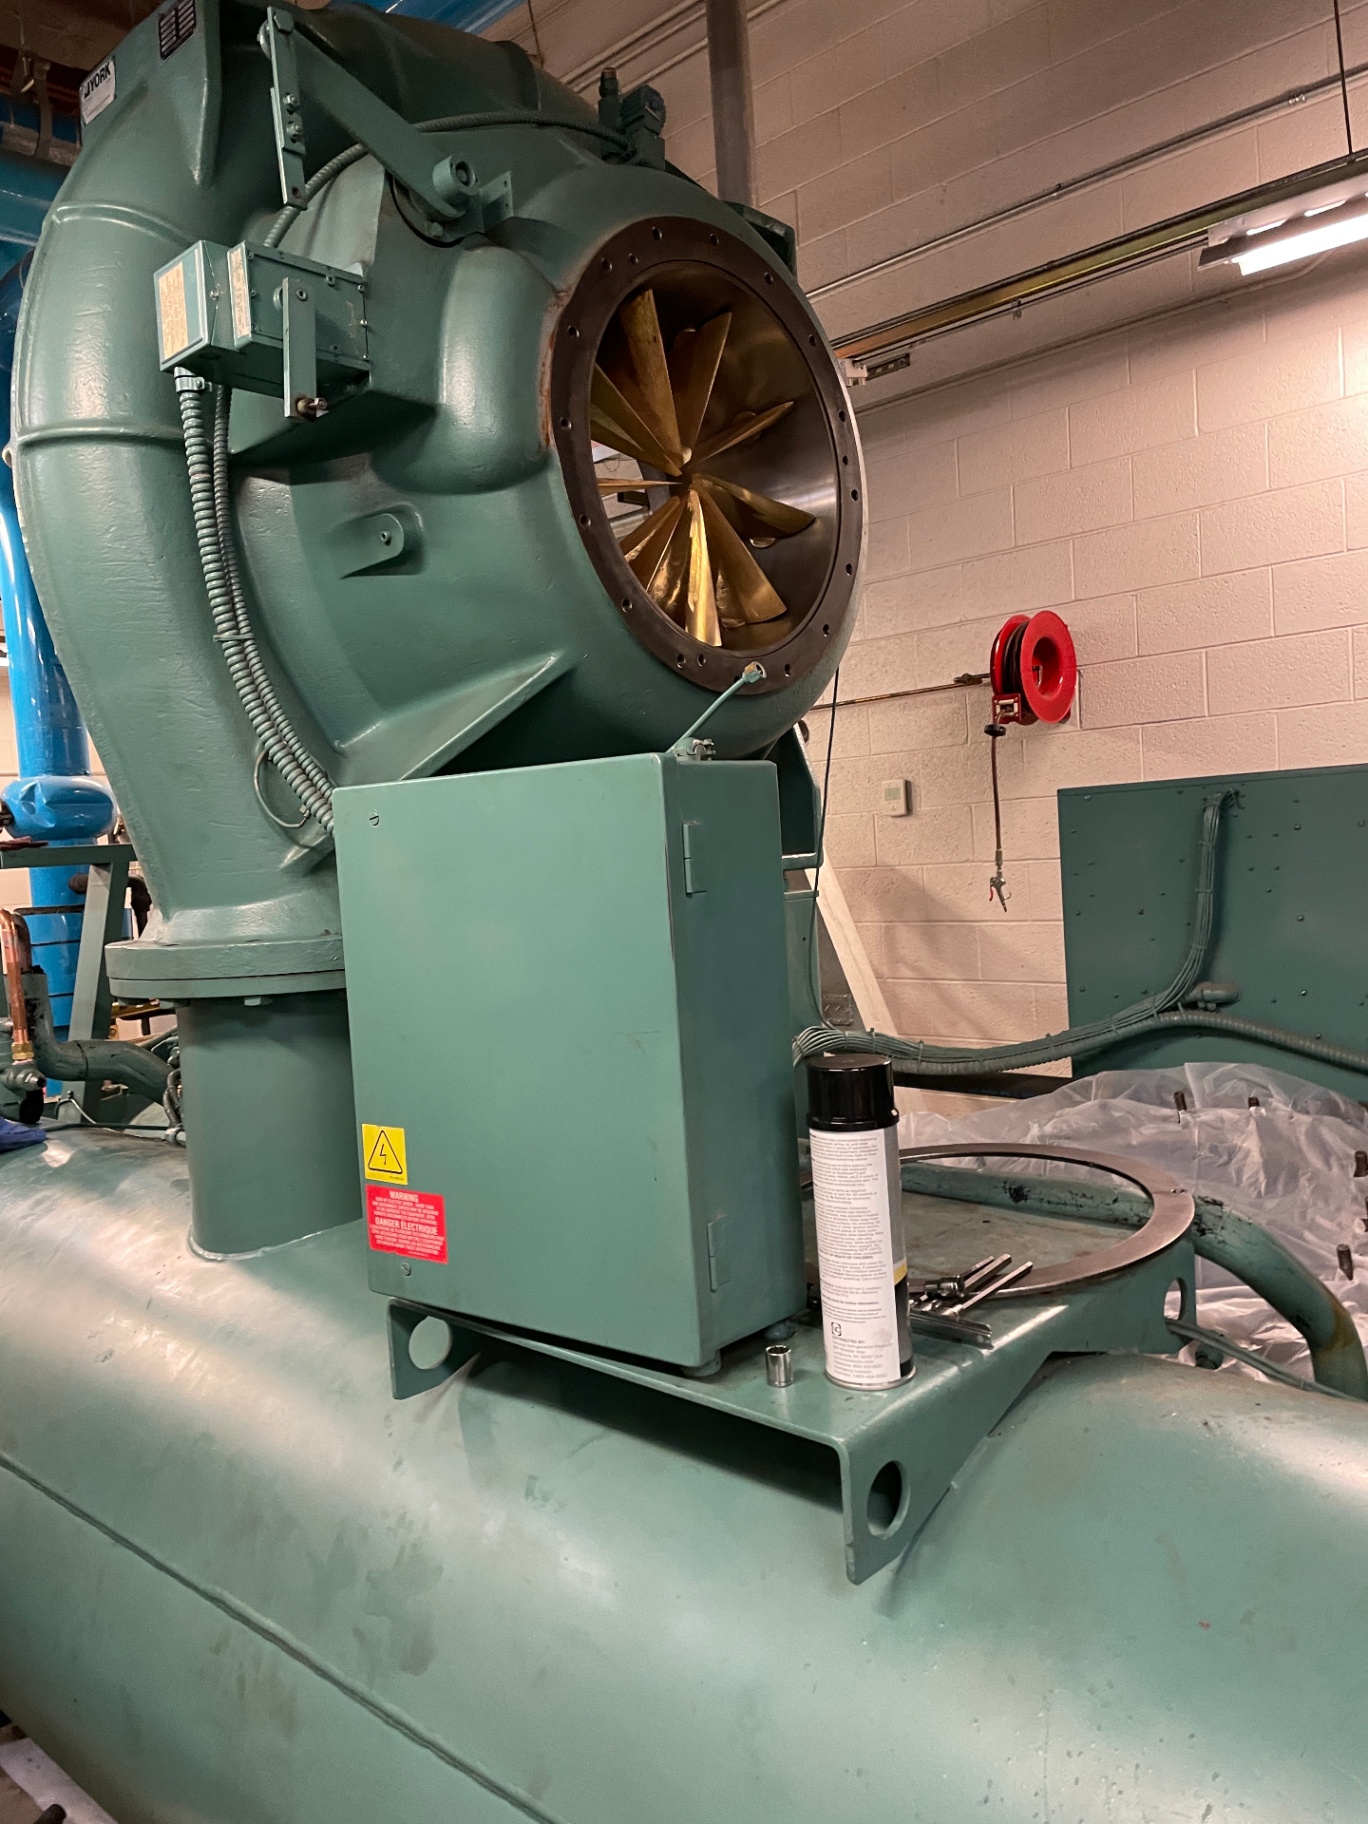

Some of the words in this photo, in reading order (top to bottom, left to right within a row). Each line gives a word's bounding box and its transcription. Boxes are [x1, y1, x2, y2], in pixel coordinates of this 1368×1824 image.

[389, 1190, 419, 1203] WARNING
[374, 1217, 400, 1229] DANGER
[400, 1220, 438, 1235] ÉLECTRIQUE
